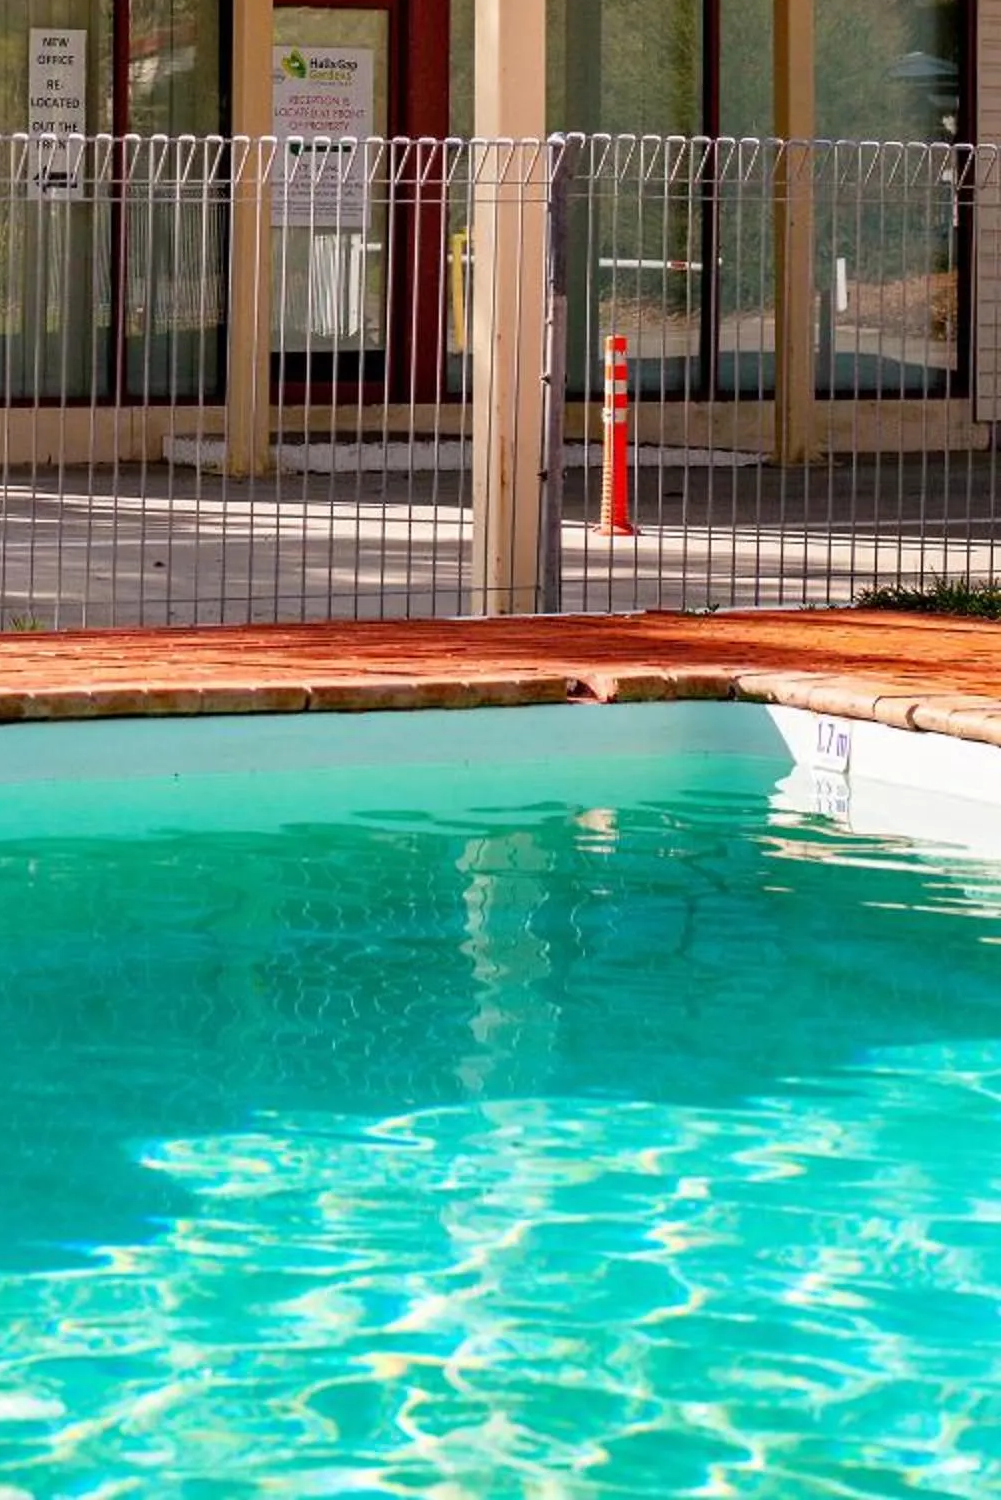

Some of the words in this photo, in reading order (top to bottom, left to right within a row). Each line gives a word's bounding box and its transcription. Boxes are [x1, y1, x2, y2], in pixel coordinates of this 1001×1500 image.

[42, 37, 70, 47] NEW
[36, 55, 75, 65] OFFICE
[30, 97, 80, 109] LOCATED
[32, 122, 55, 132] OUT
